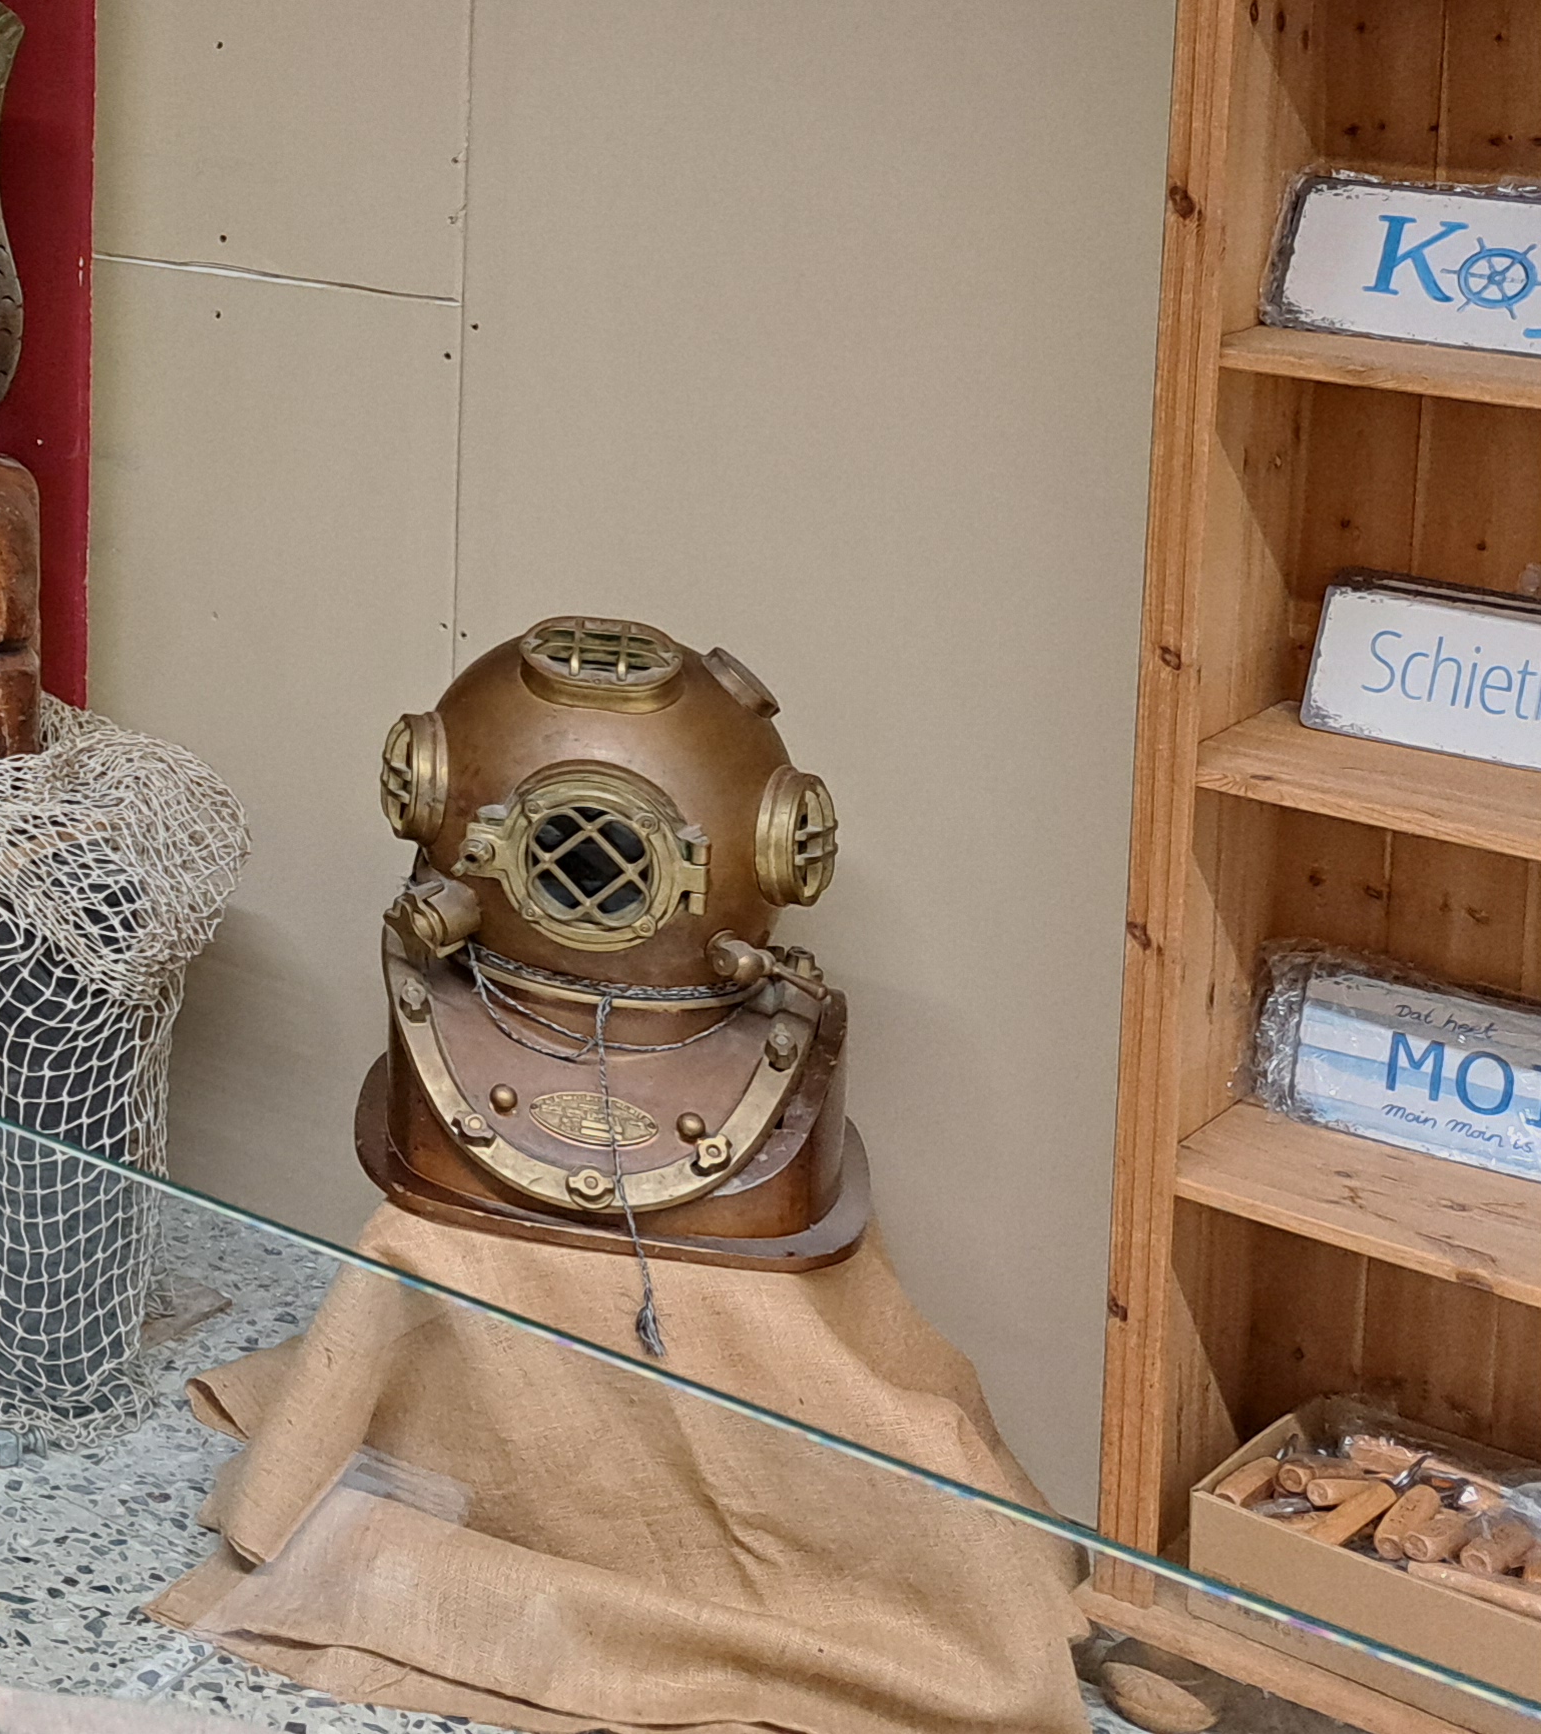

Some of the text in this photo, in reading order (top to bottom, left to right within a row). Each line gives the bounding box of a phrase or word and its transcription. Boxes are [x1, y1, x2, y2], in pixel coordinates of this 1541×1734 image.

[1361, 629, 1541, 721] Schiet
[1395, 1004, 1436, 1025] Dat
[1386, 1030, 1541, 1128] MO
